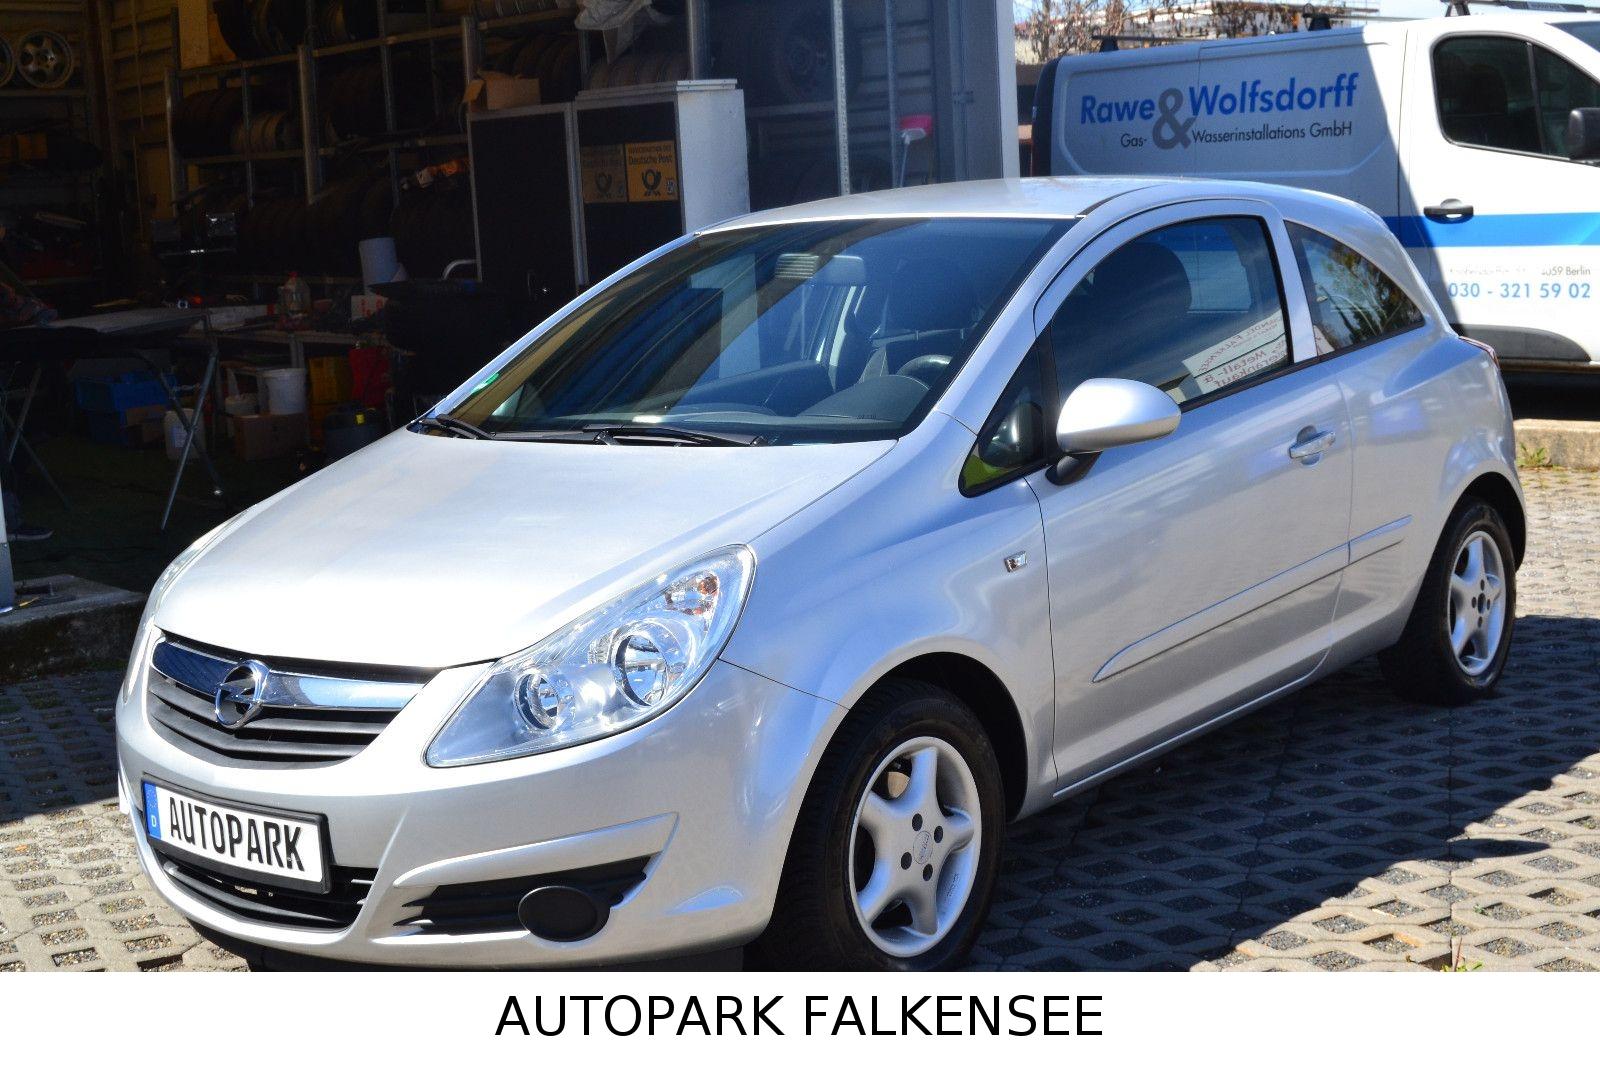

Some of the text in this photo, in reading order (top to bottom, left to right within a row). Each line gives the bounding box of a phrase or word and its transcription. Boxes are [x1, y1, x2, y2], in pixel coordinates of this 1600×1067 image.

[1080, 72, 1359, 150] Rawe & Wolfsdorff
[1120, 120, 1353, 148] Gas- Wasserinstallations GmbH
[1565, 265, 1591, 276] Berlin
[1448, 282, 1480, 298] 030
[1500, 283, 1530, 298] 321
[1540, 283, 1561, 298] 59
[1568, 283, 1591, 298] 02
[151, 815, 157, 828] D
[169, 796, 305, 872] AUTOPARK
